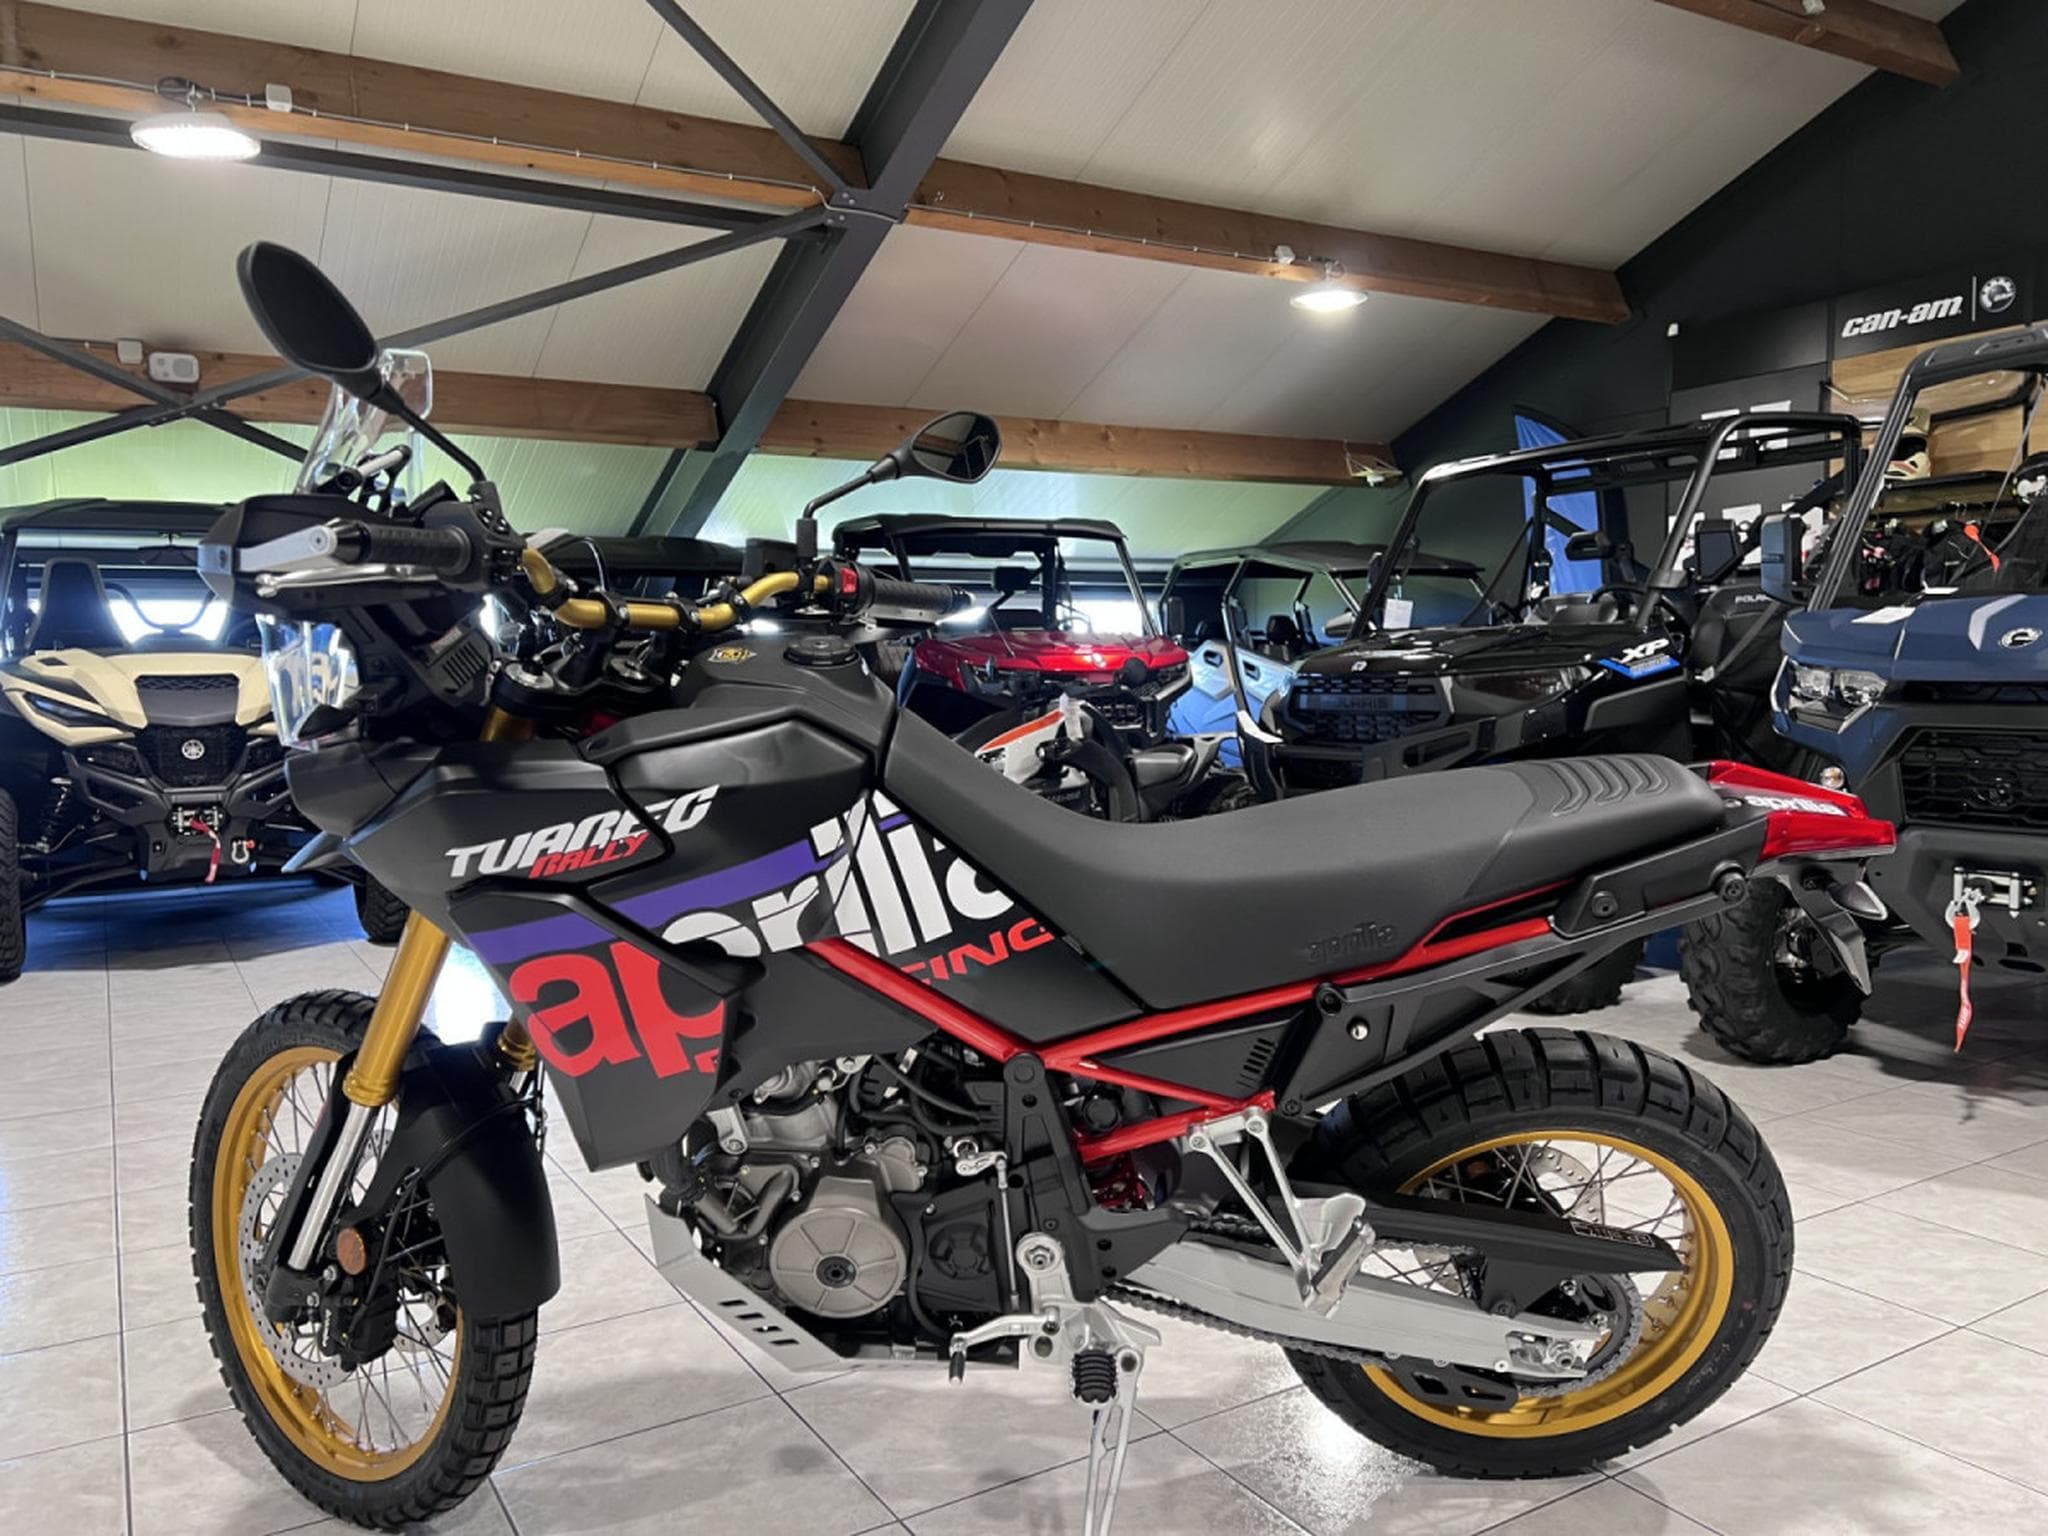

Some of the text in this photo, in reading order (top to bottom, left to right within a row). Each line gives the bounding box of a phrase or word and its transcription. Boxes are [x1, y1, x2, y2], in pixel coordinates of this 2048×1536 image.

[1841, 295, 1963, 338] can-am
[1620, 638, 1669, 664] XP
[446, 784, 720, 878] TUAREG
[529, 832, 650, 879] RALLY
